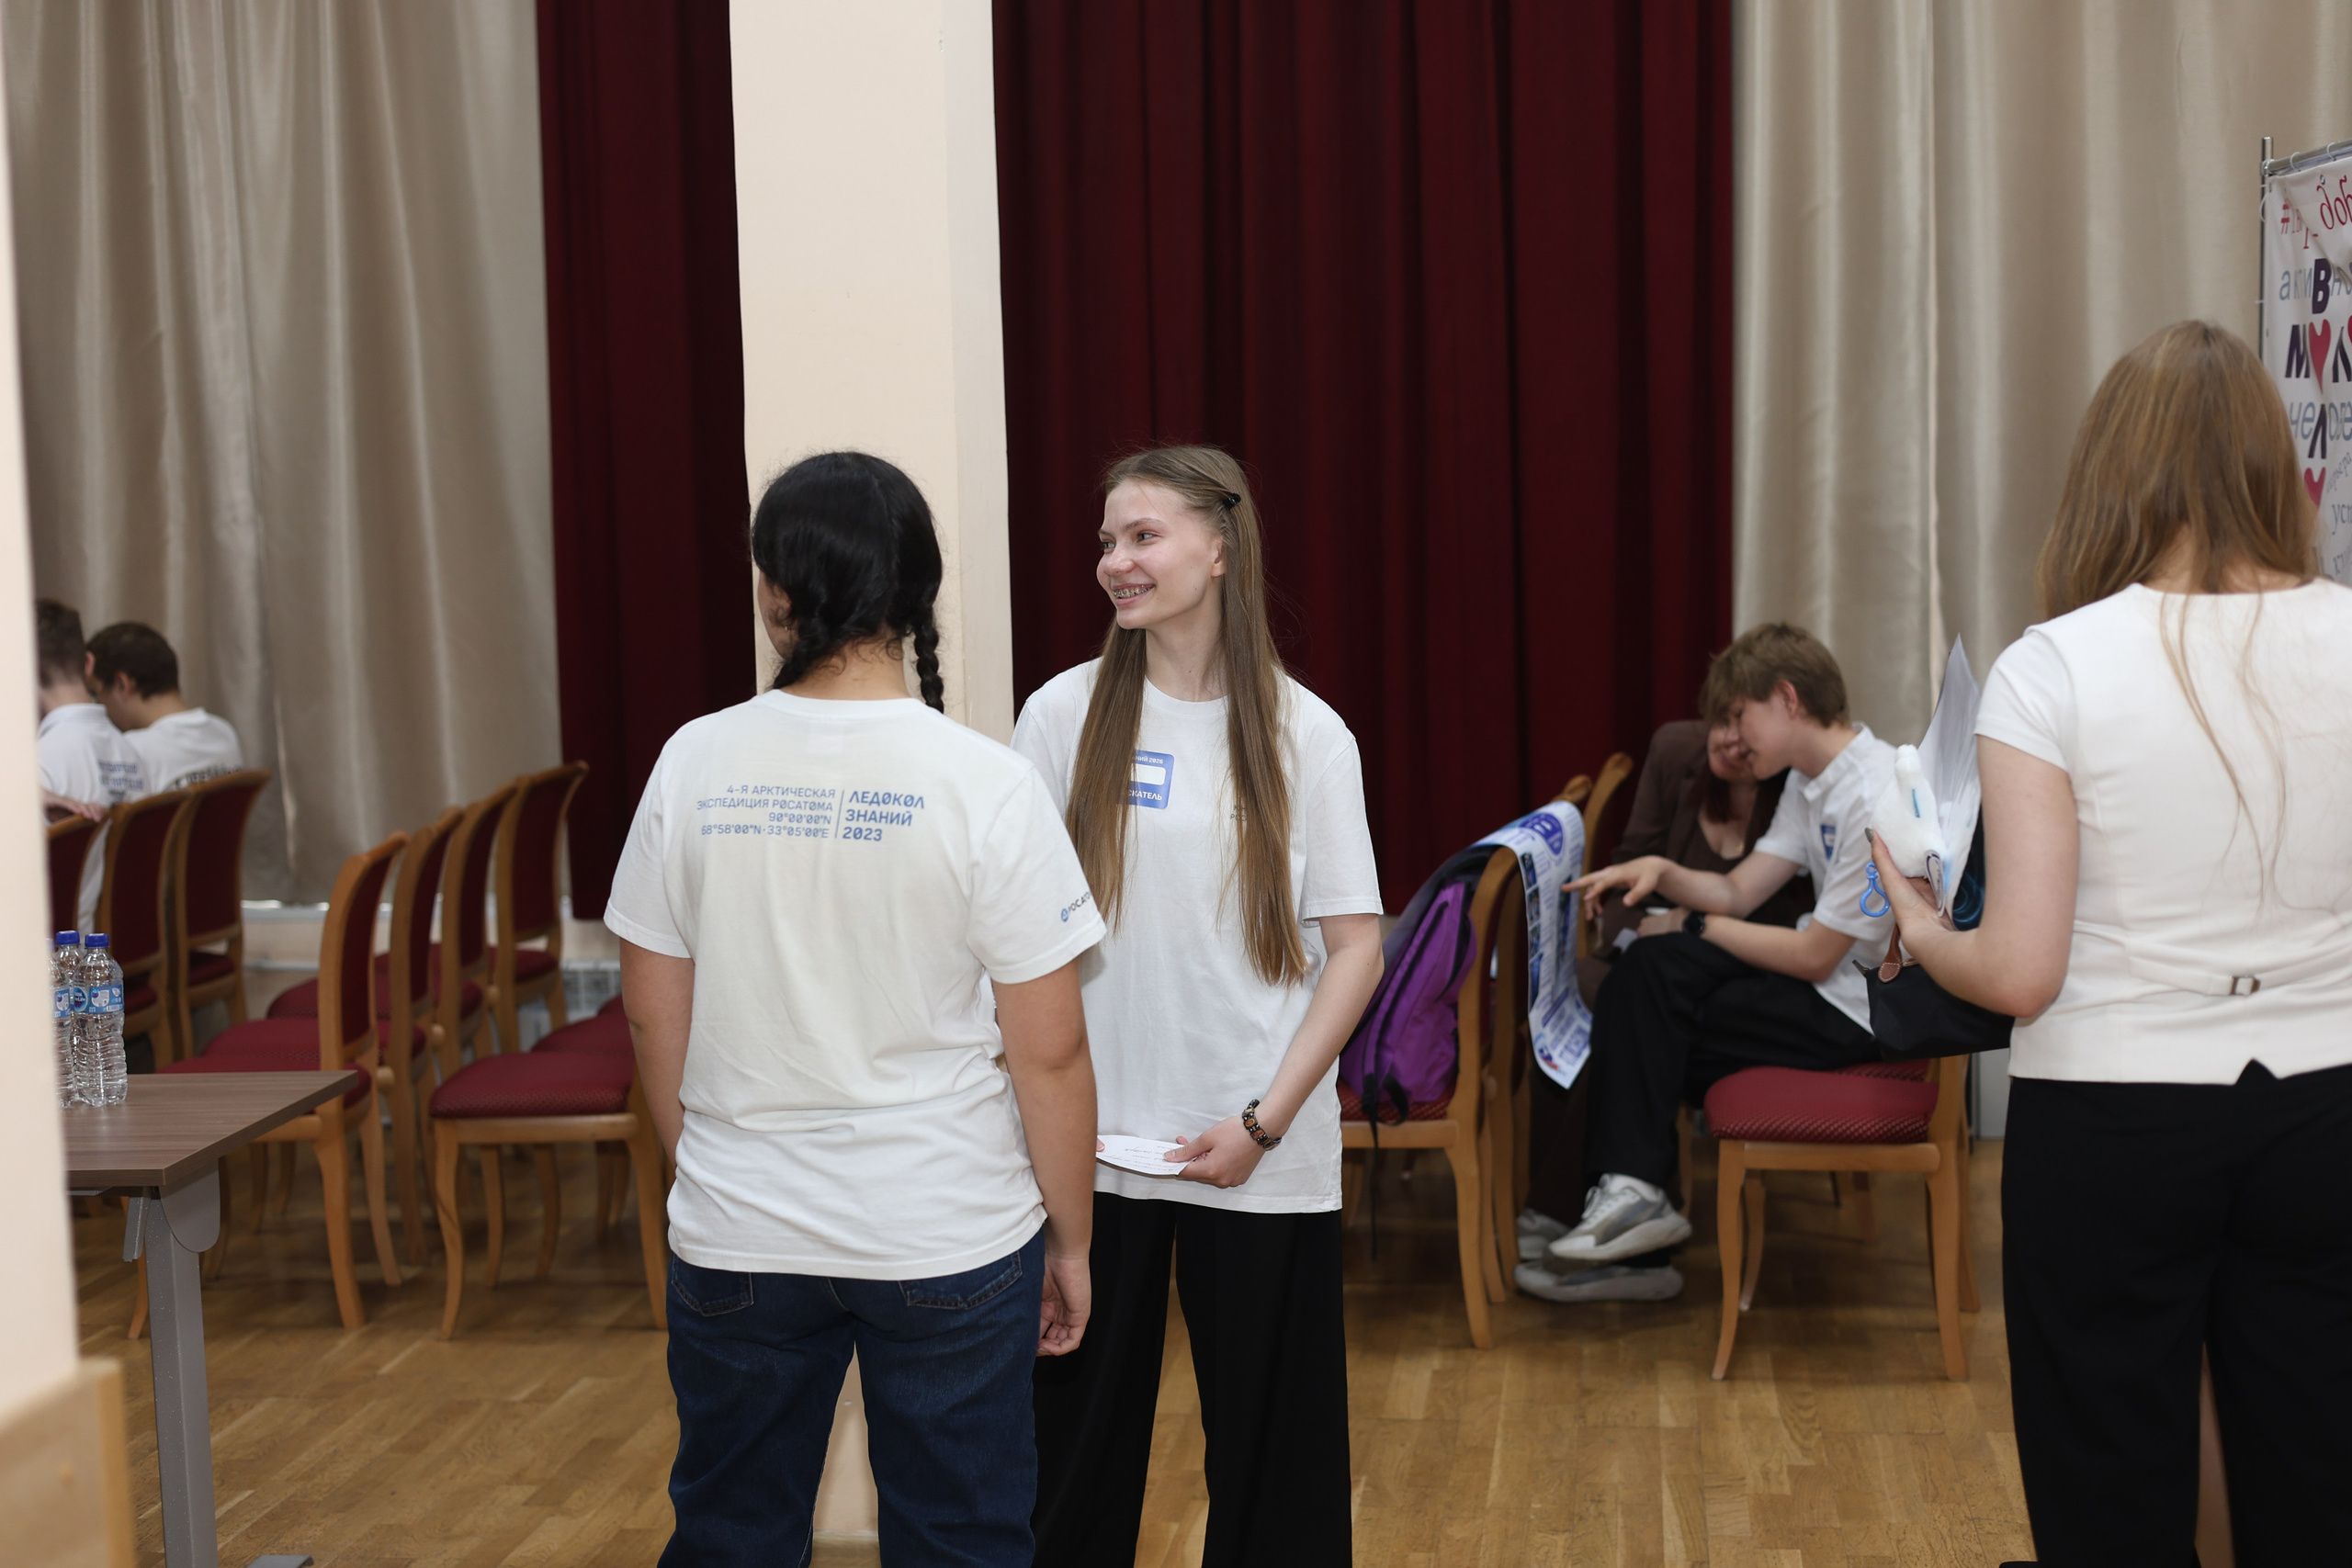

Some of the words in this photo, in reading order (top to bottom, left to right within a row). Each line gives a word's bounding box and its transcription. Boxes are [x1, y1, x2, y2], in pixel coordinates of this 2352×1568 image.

[727, 784, 749, 795] 4-Я
[752, 785, 836, 798] АРКТИЧЕСКАЯ
[696, 797, 769, 810] ЭКСПЕДИЦИЯ
[772, 798, 833, 812] РОСАТОМА
[848, 790, 924, 809] ЛЕДОКОЛ
[845, 808, 912, 827] ЗНАНИЙ
[842, 826, 883, 841] 2023
